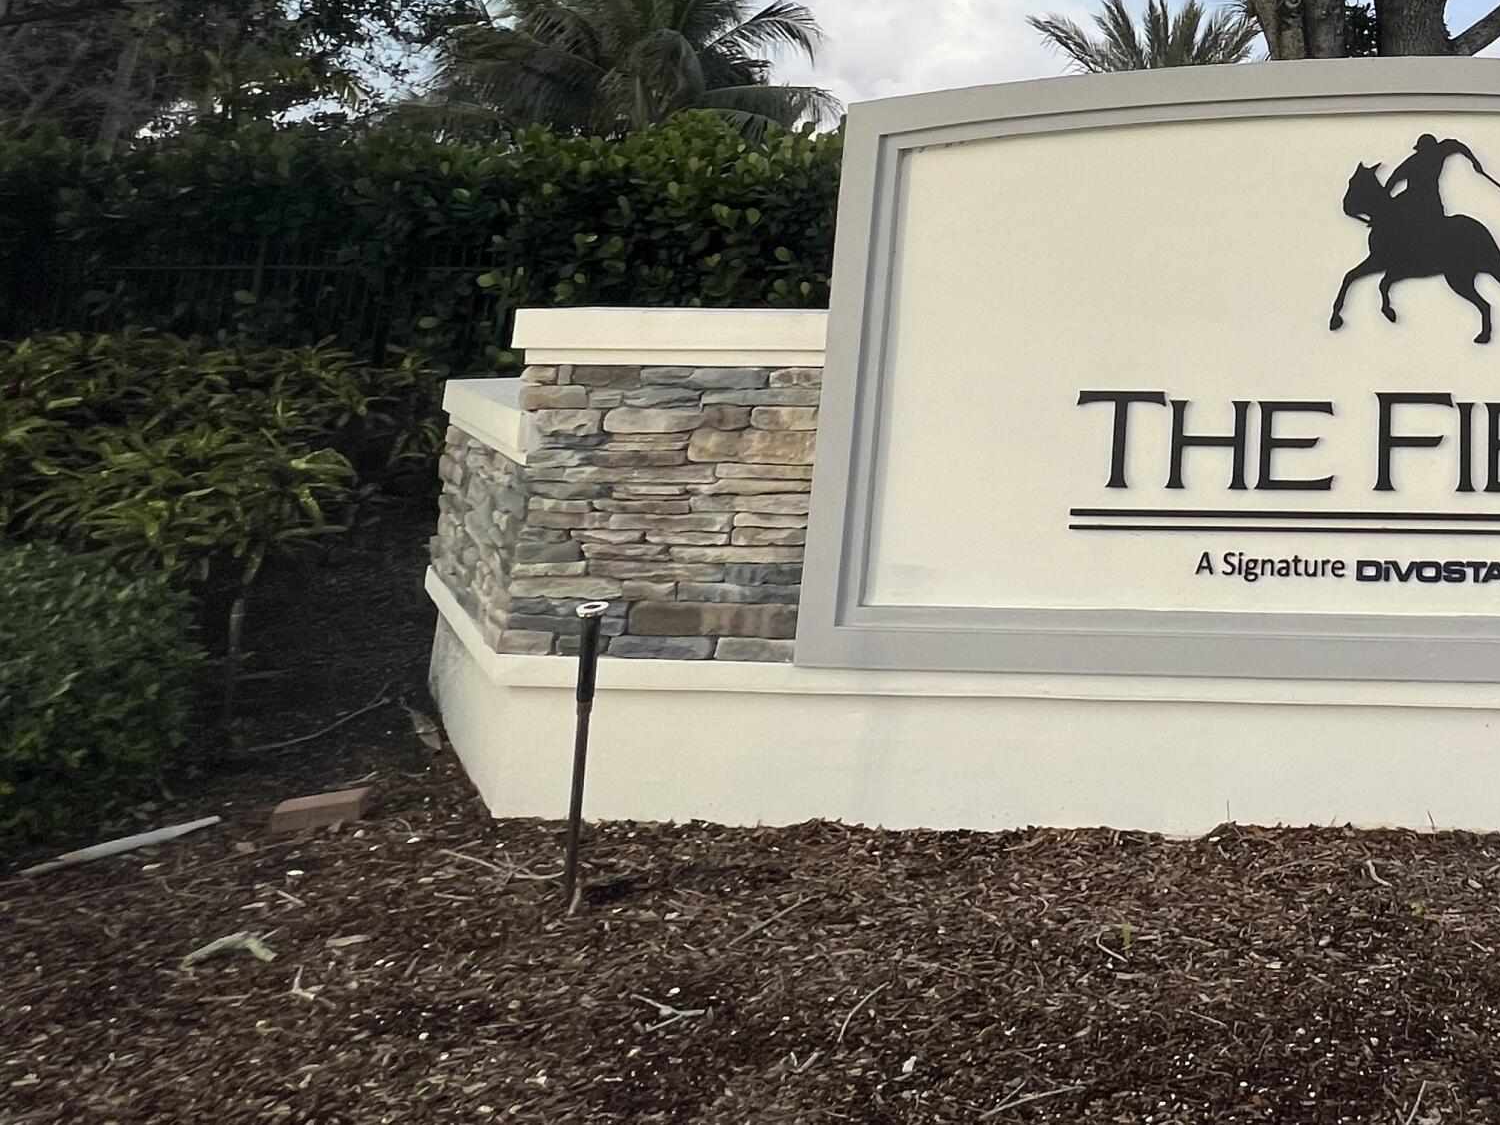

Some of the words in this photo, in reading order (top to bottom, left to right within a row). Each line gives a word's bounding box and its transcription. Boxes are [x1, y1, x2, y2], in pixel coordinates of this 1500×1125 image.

[1077, 391, 1334, 491] THE
[1195, 551, 1214, 576] A
[1221, 552, 1346, 583] Signature
